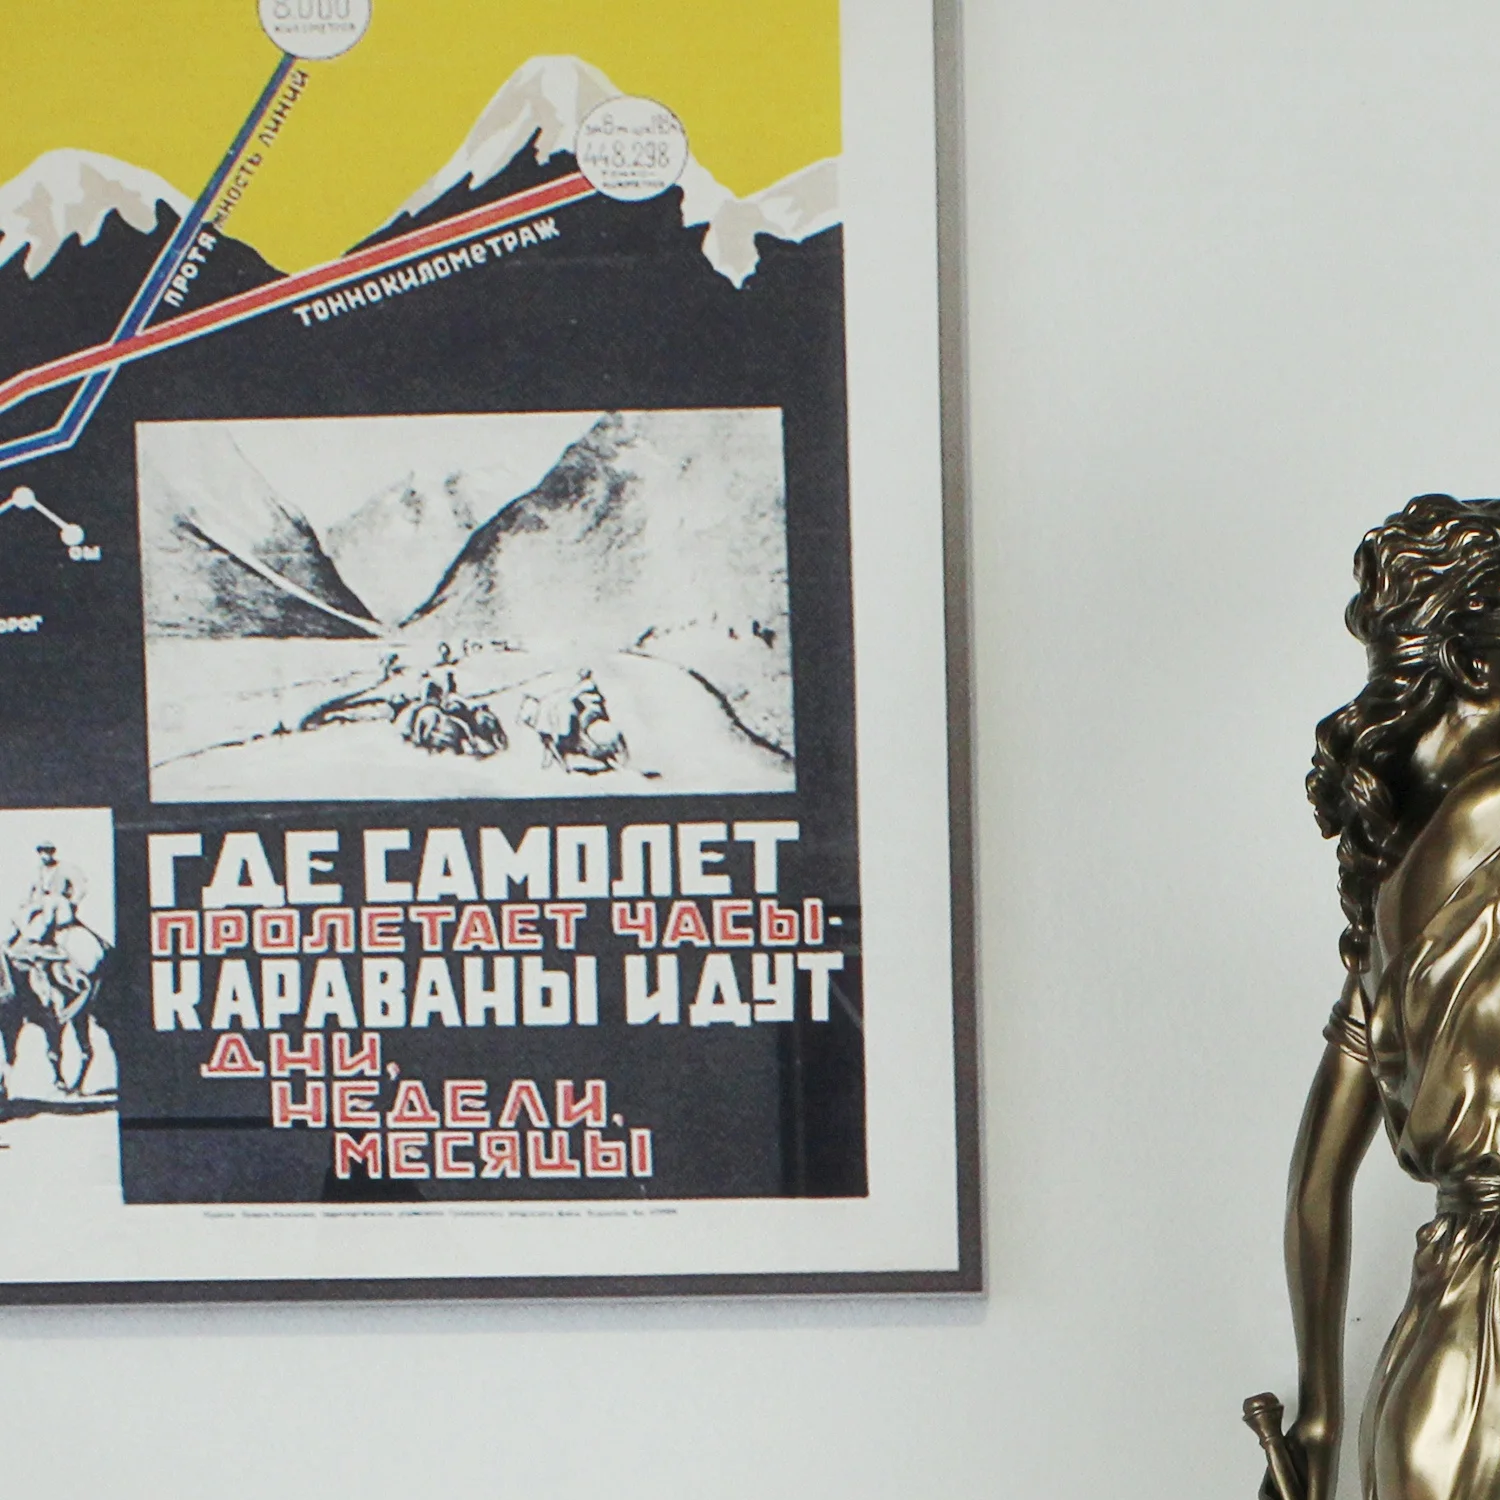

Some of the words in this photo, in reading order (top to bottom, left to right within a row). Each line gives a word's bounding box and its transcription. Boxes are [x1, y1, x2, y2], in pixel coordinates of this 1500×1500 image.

[259, 70, 310, 148] ЛИНИЙ
[148, 831, 343, 908] ГДЕ
[363, 821, 799, 902] САМОЛЕТ
[151, 903, 586, 956] ПРОЛЕТАЕТ
[152, 954, 598, 1031] КАРАВАНЫ
[624, 952, 844, 1027] ИДУТ
[201, 1032, 400, 1080] ДНИ,
[333, 1128, 653, 1179] МЕСЯЦЫ
